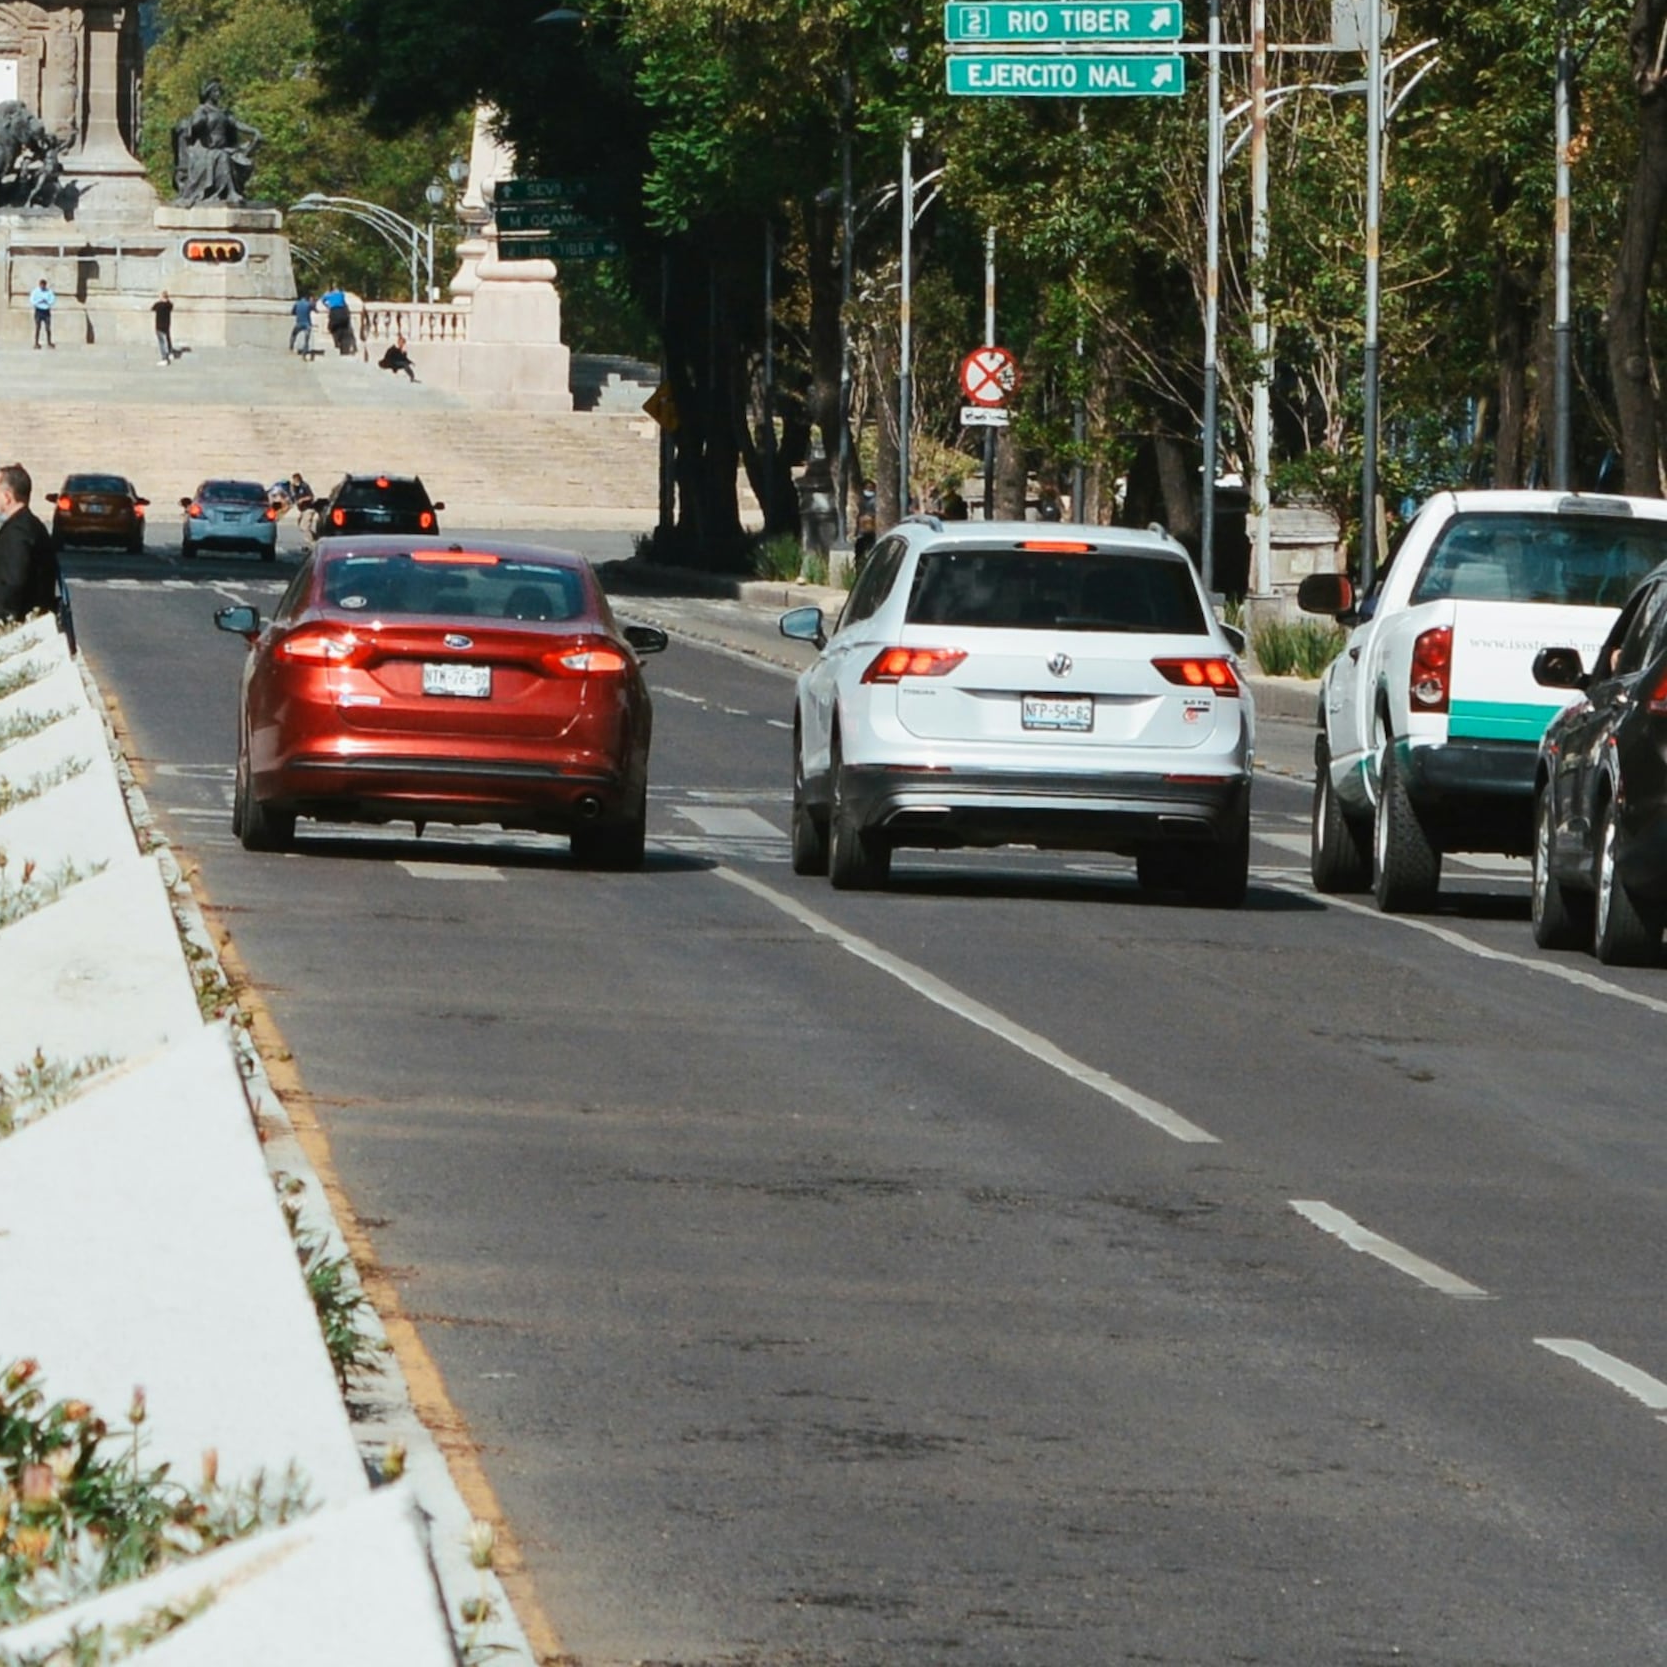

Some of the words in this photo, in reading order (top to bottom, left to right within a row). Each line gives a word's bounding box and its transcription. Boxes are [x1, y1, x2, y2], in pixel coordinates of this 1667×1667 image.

[1008, 10, 1049, 33] RIO
[1060, 9, 1131, 33] TIBER
[968, 63, 1077, 87] EJERCITO
[1088, 63, 1137, 88] NAL
